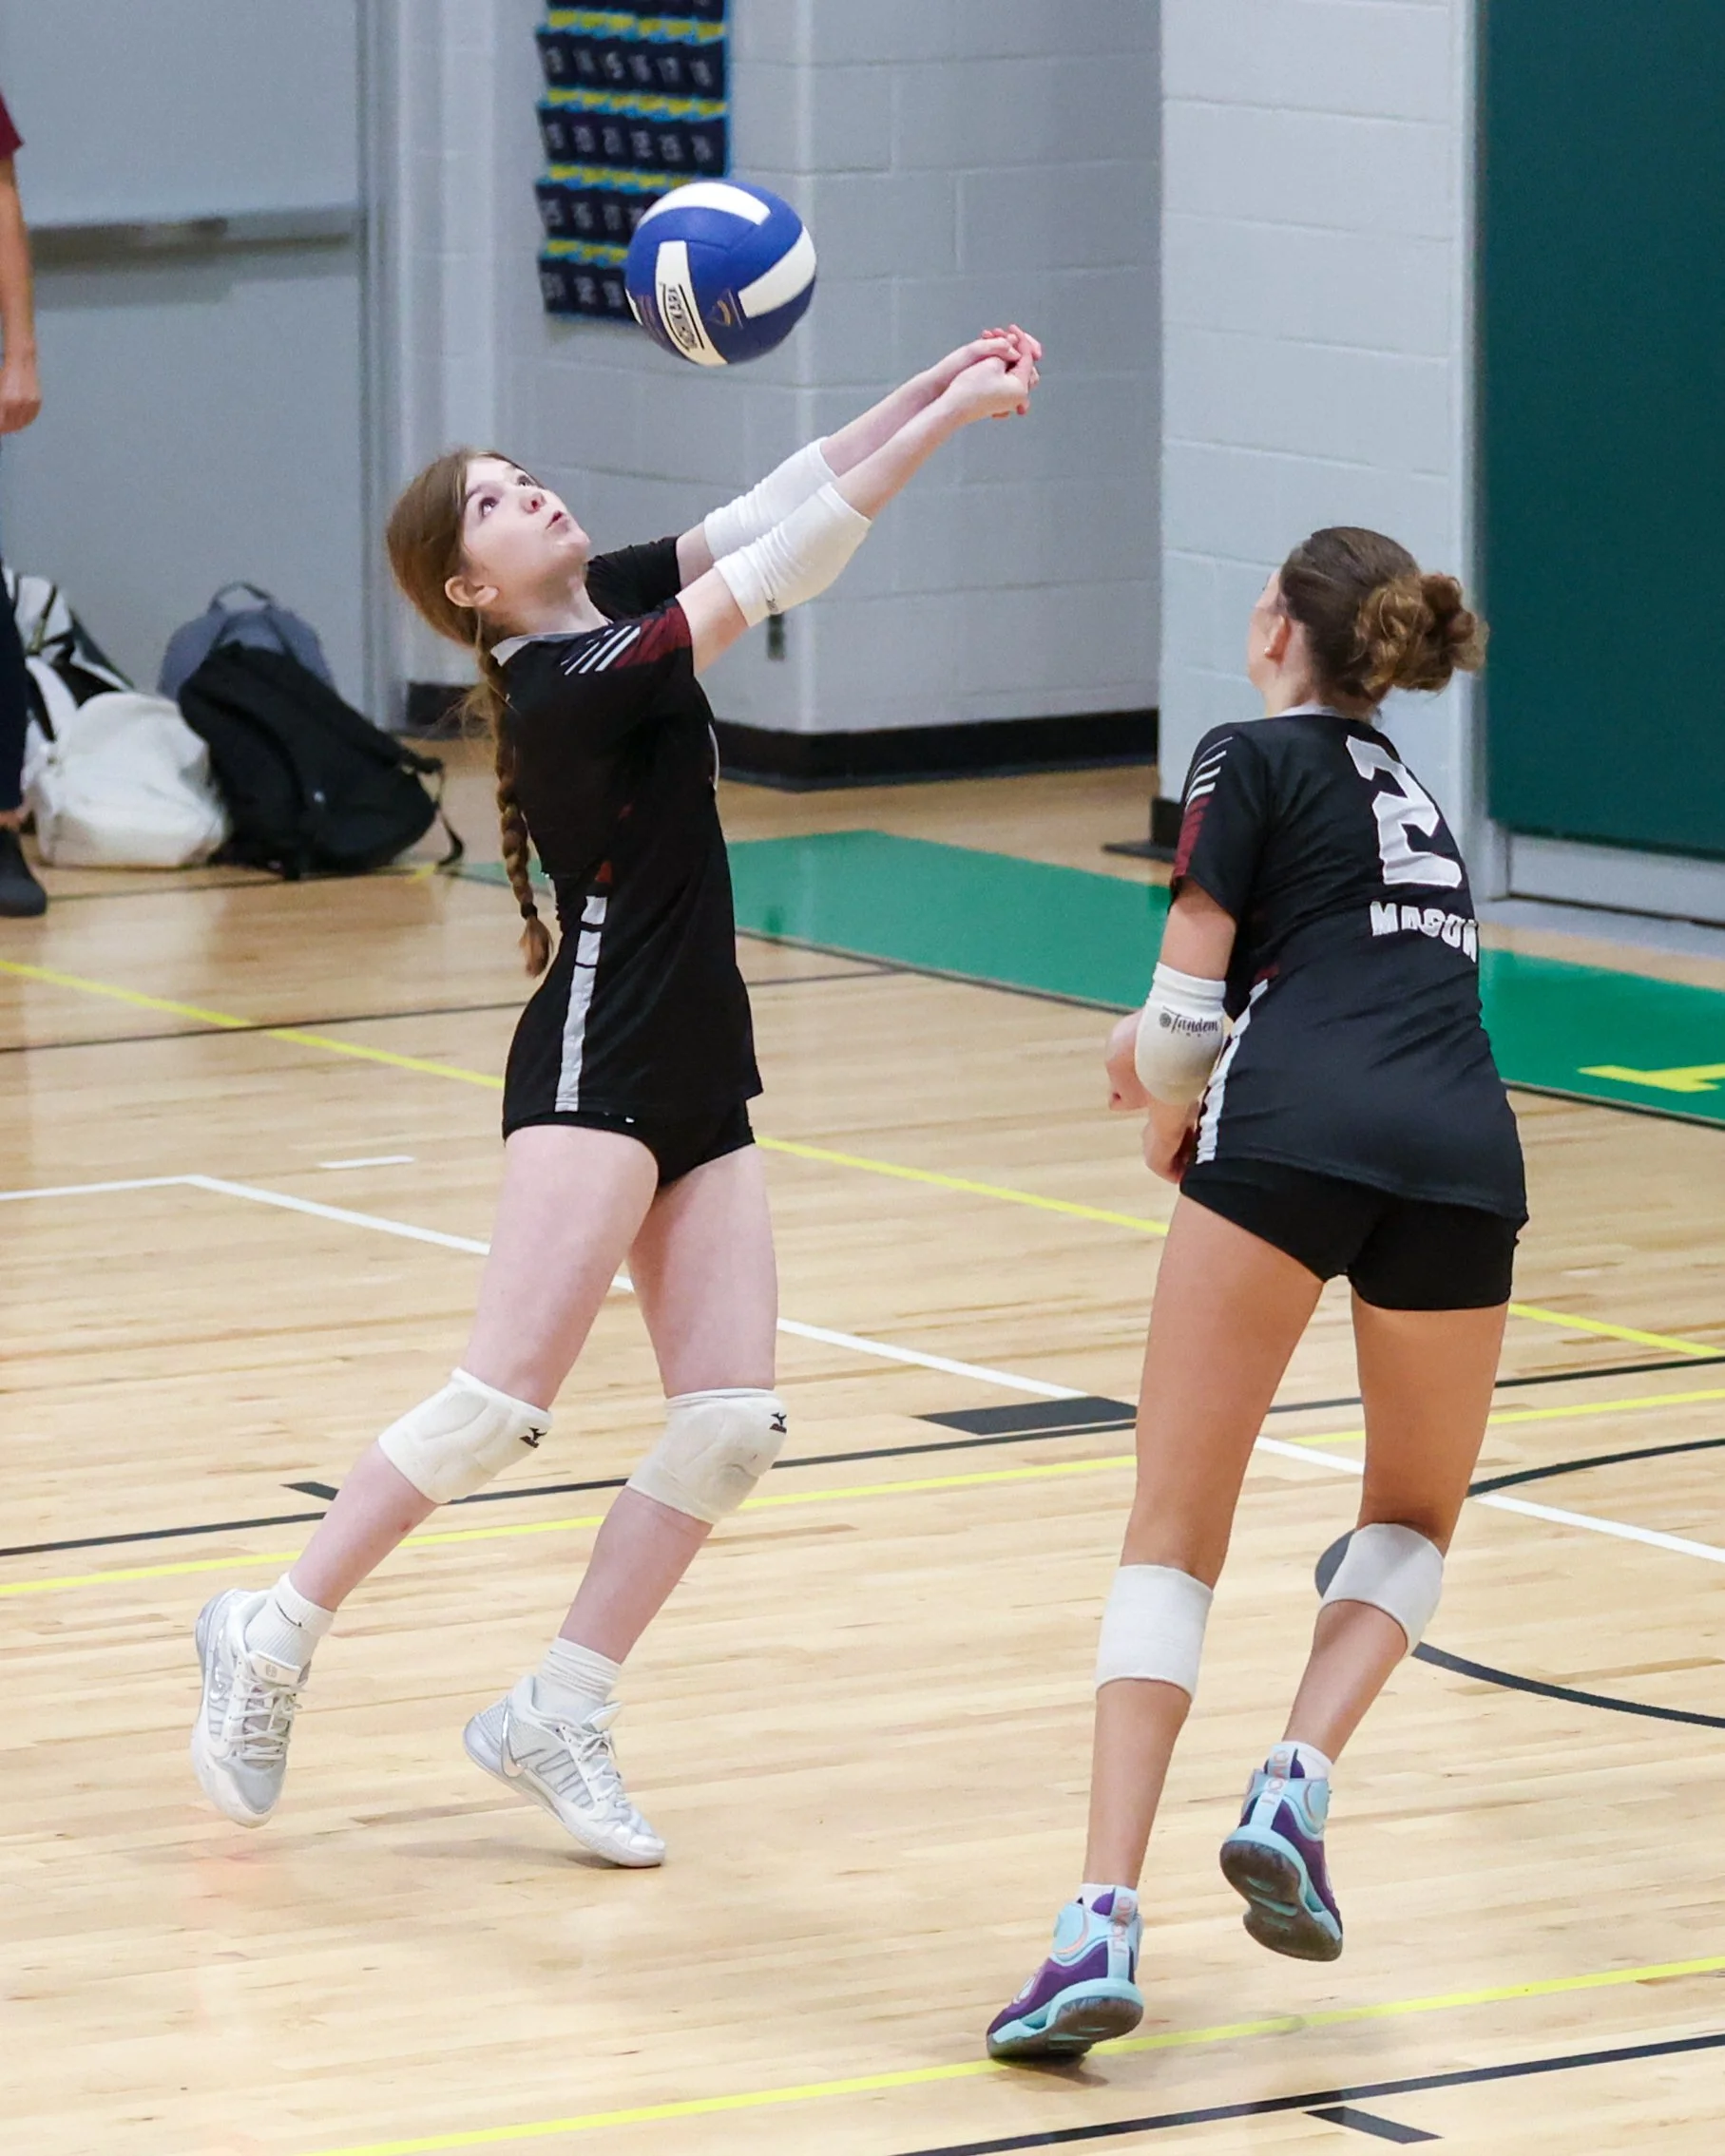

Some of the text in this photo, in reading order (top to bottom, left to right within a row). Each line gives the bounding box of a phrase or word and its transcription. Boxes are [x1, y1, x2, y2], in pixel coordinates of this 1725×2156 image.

[1345, 735, 1463, 888] 2
[1370, 901, 1478, 964] MASON
[1162, 1005, 1218, 1034] Tandem
